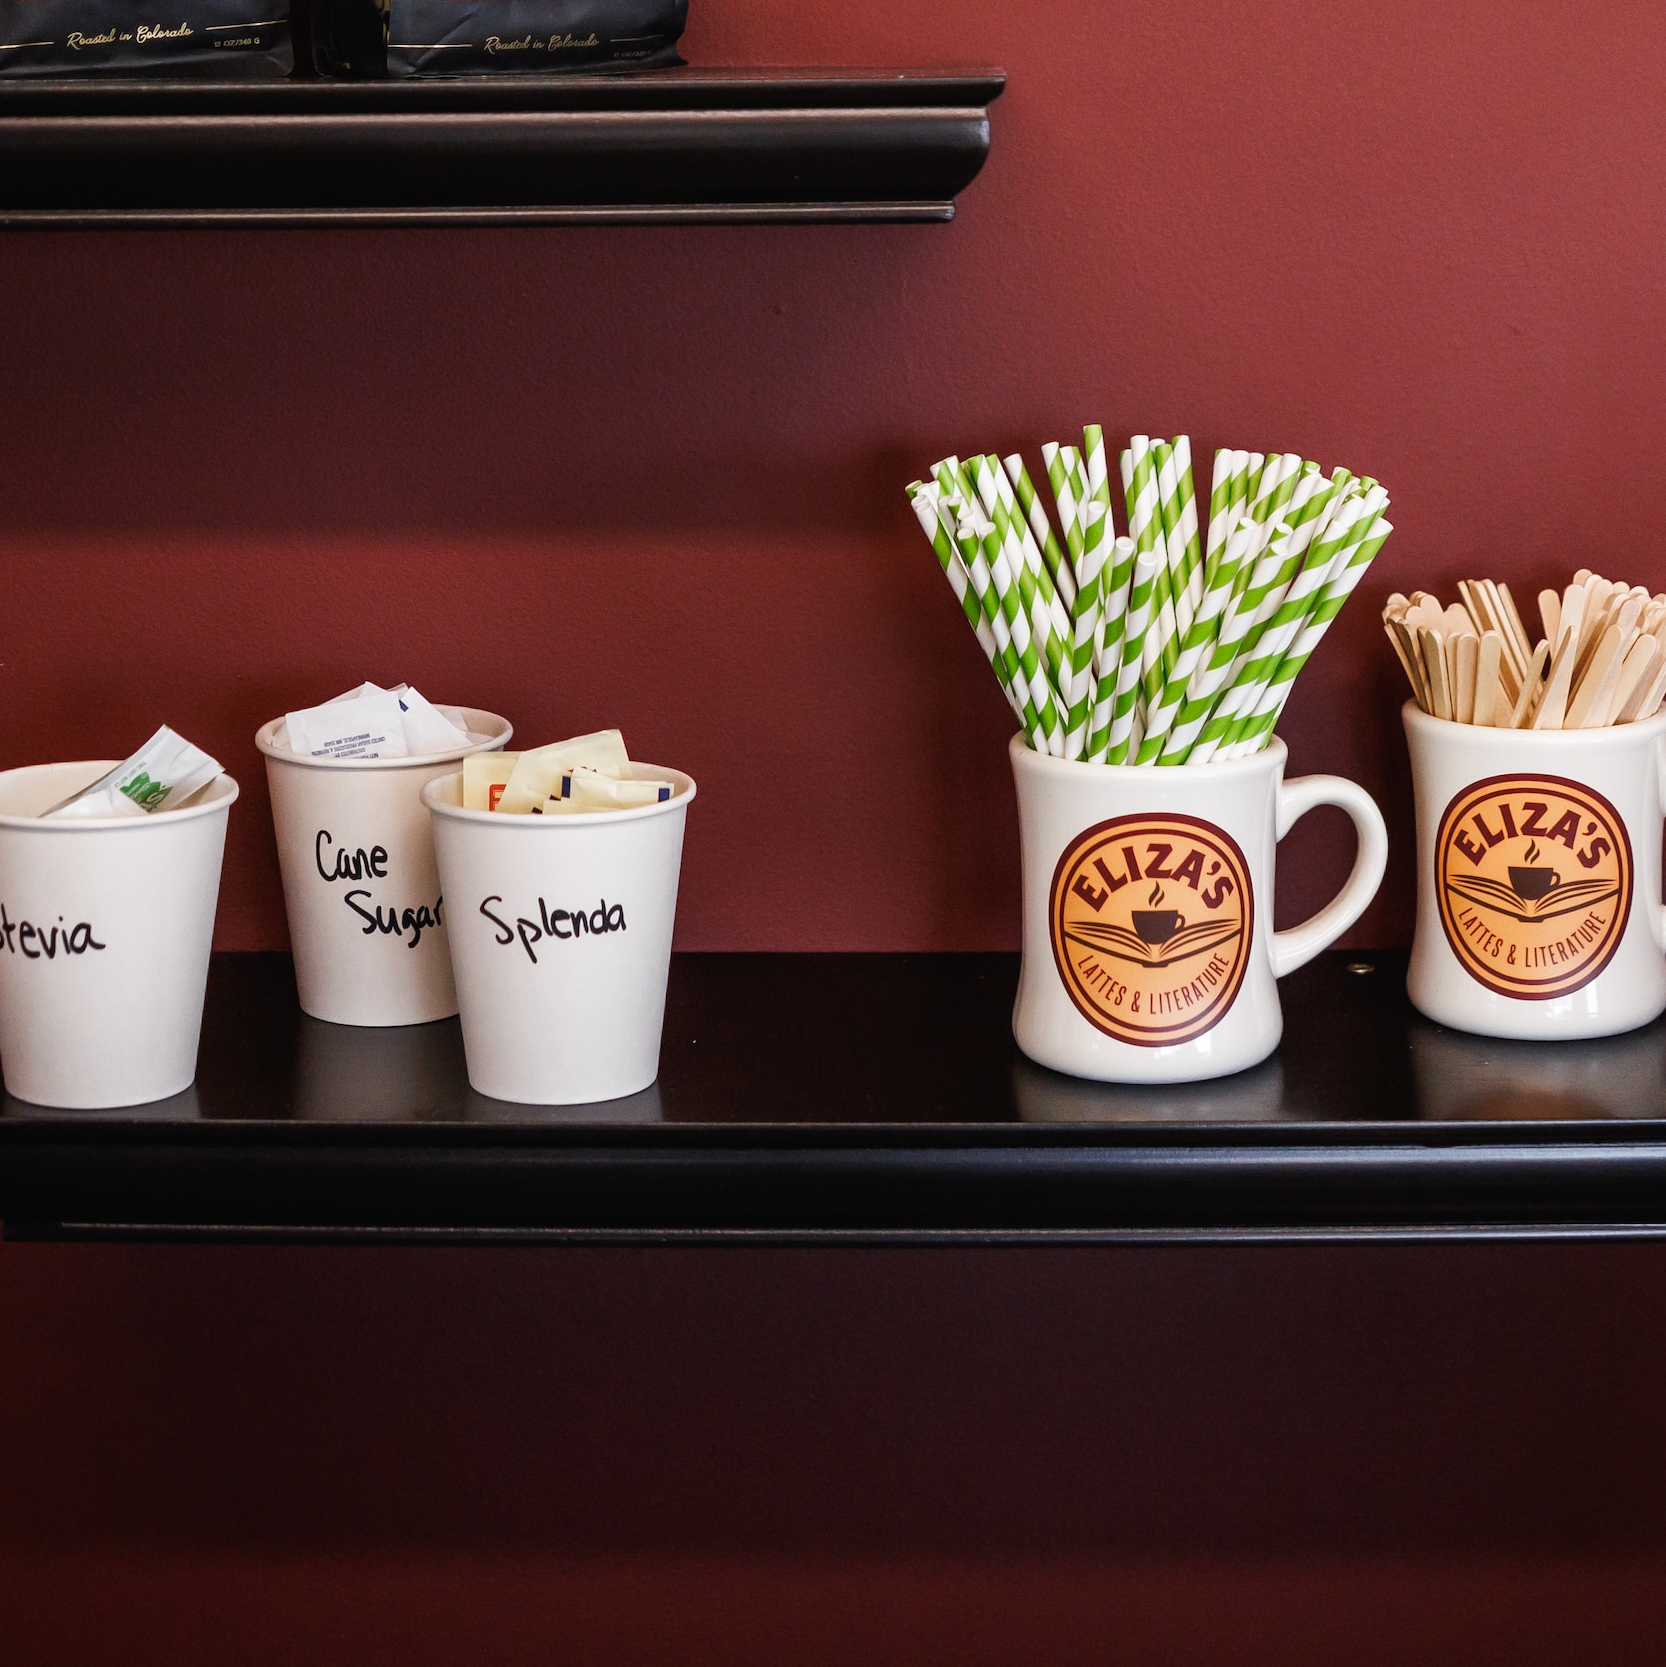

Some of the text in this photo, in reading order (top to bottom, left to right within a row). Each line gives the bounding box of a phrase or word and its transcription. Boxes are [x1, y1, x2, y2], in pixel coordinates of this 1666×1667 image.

[67, 22, 195, 50] Roasted in Colorado
[483, 33, 600, 55] Roasted in Colorado
[316, 830, 388, 882] Cane
[1454, 802, 1611, 868] ELIZA'S
[1071, 843, 1234, 912] ELIZA'S
[344, 890, 443, 948] Sugar
[480, 896, 627, 964] Splenda
[1458, 907, 1606, 967] LATTES & LITERATURE
[1078, 952, 1229, 1015] LATTES & LITERATURE
